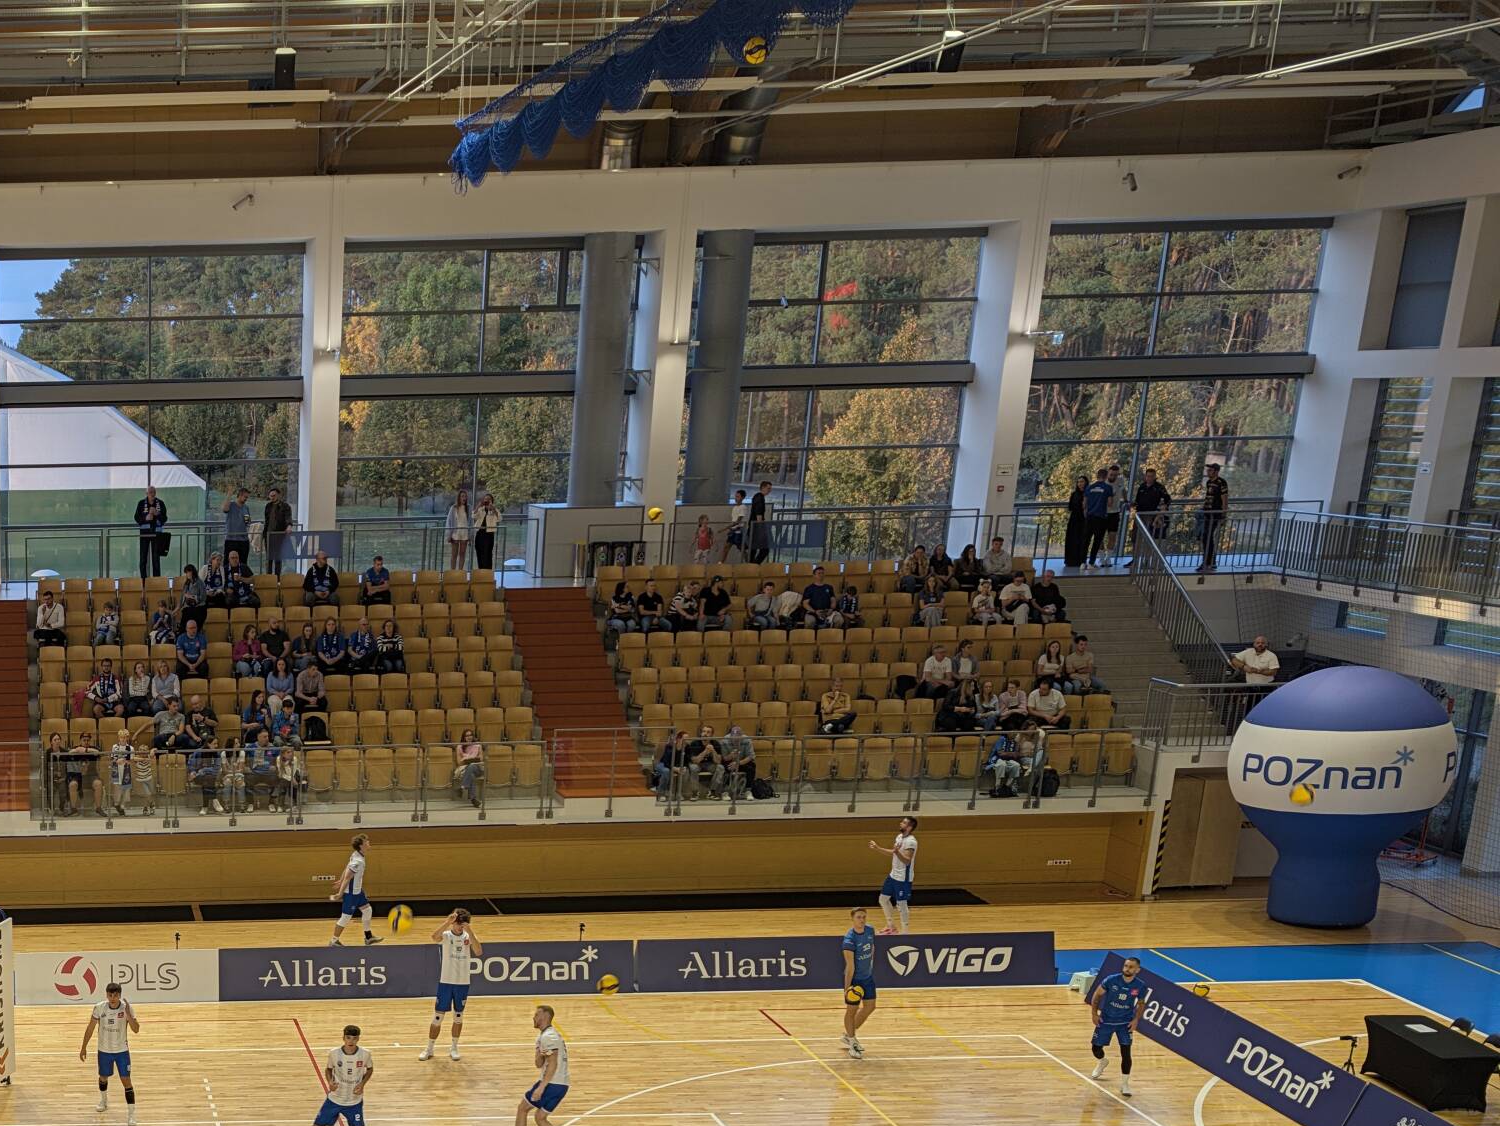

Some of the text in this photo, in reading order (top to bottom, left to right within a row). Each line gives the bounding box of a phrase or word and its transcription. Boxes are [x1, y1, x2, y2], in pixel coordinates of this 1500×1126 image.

[111, 962, 181, 991] PLS
[259, 959, 387, 988] Allaris
[678, 950, 808, 979] Allaris
